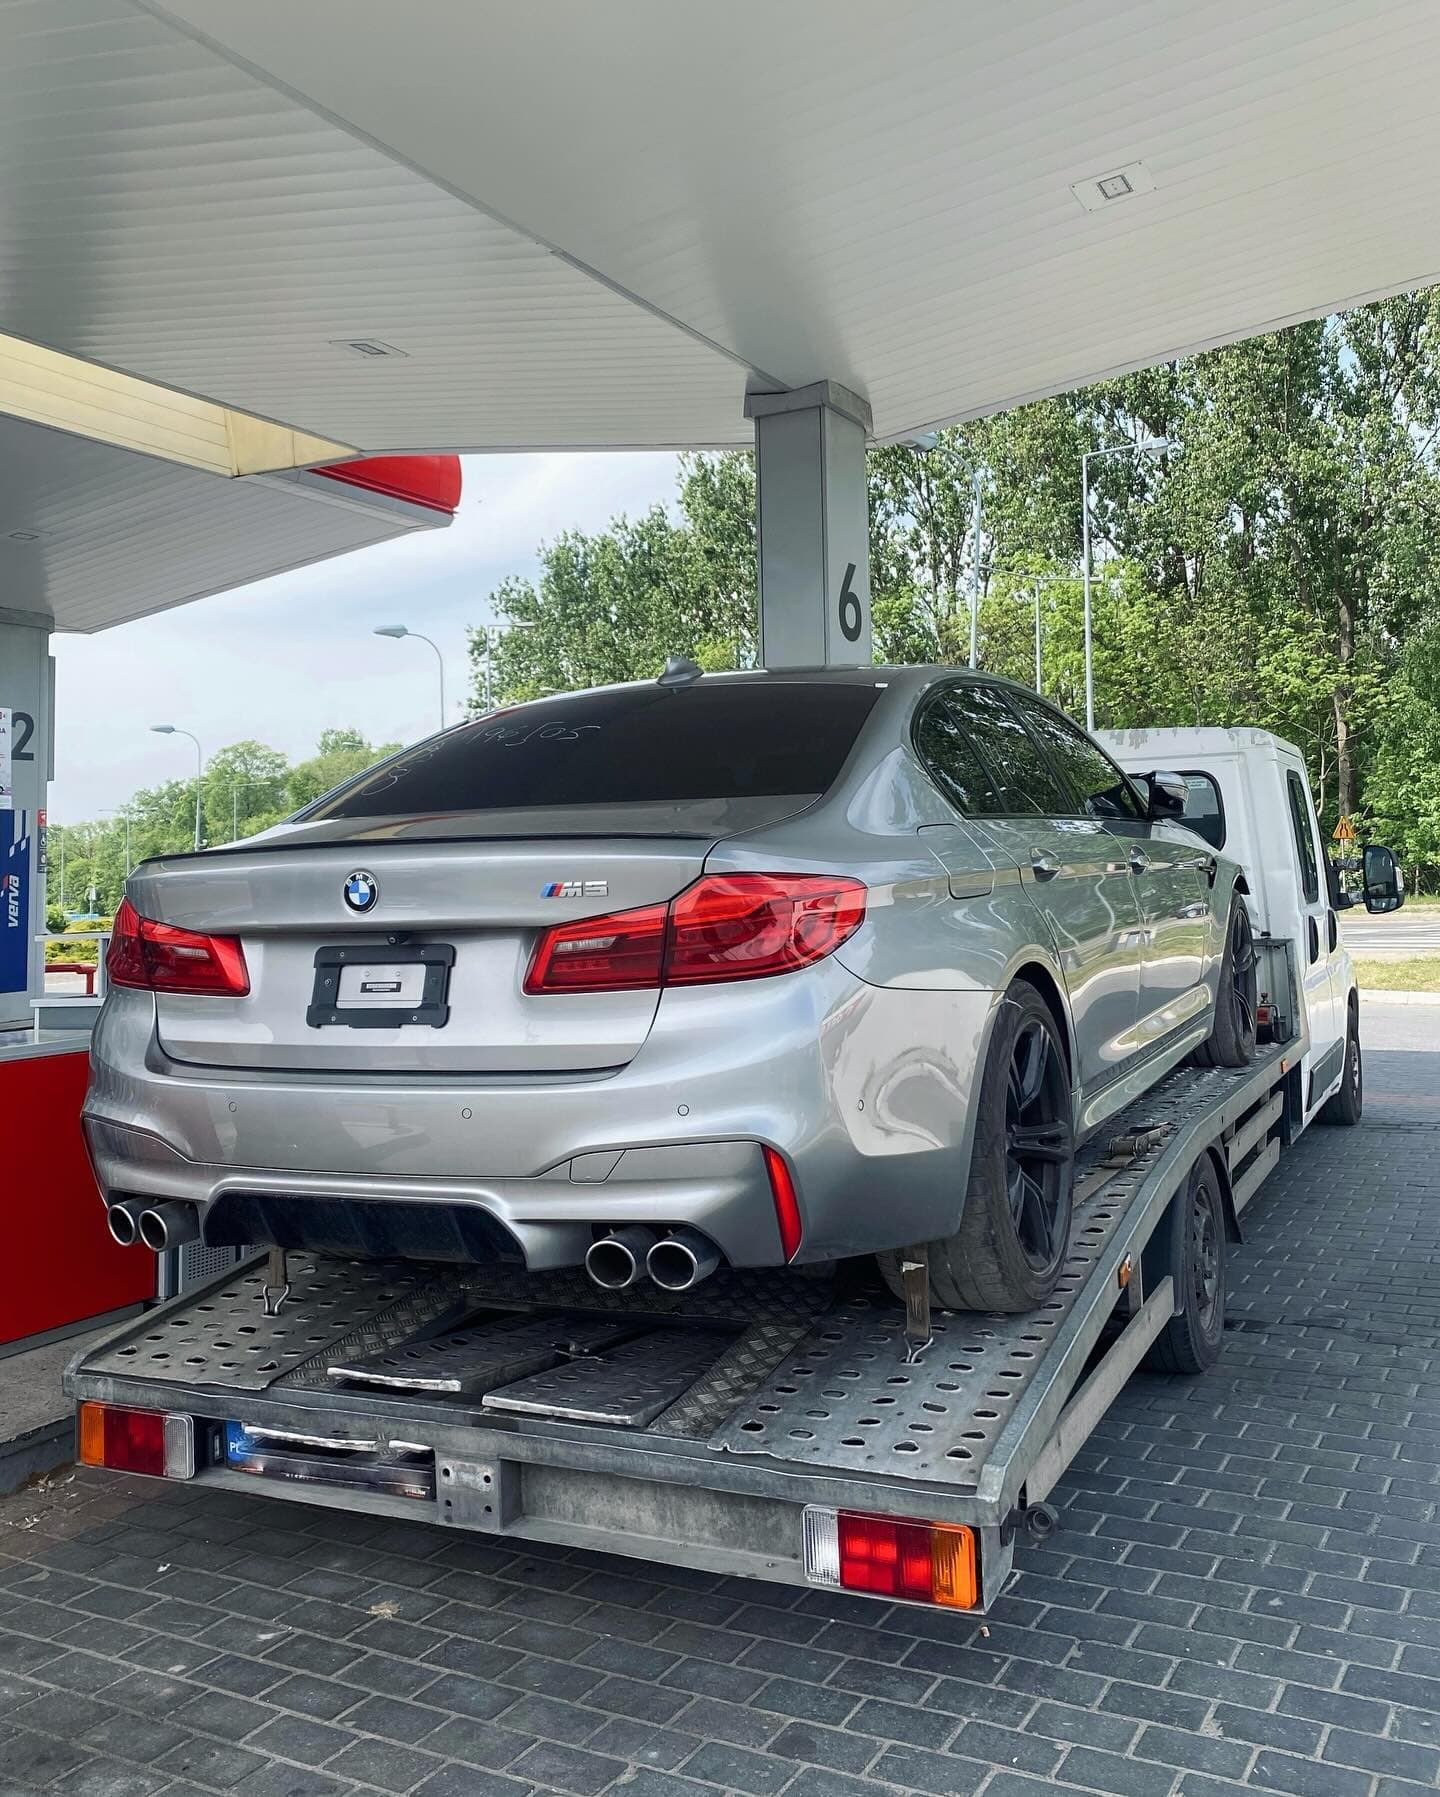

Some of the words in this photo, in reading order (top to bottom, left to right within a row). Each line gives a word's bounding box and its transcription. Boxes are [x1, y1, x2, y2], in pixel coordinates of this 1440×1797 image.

[838, 562, 862, 642] 6
[11, 711, 35, 761] 2
[8, 874, 20, 928] verva
[345, 873, 375, 887] BMW
[557, 880, 609, 898] M5
